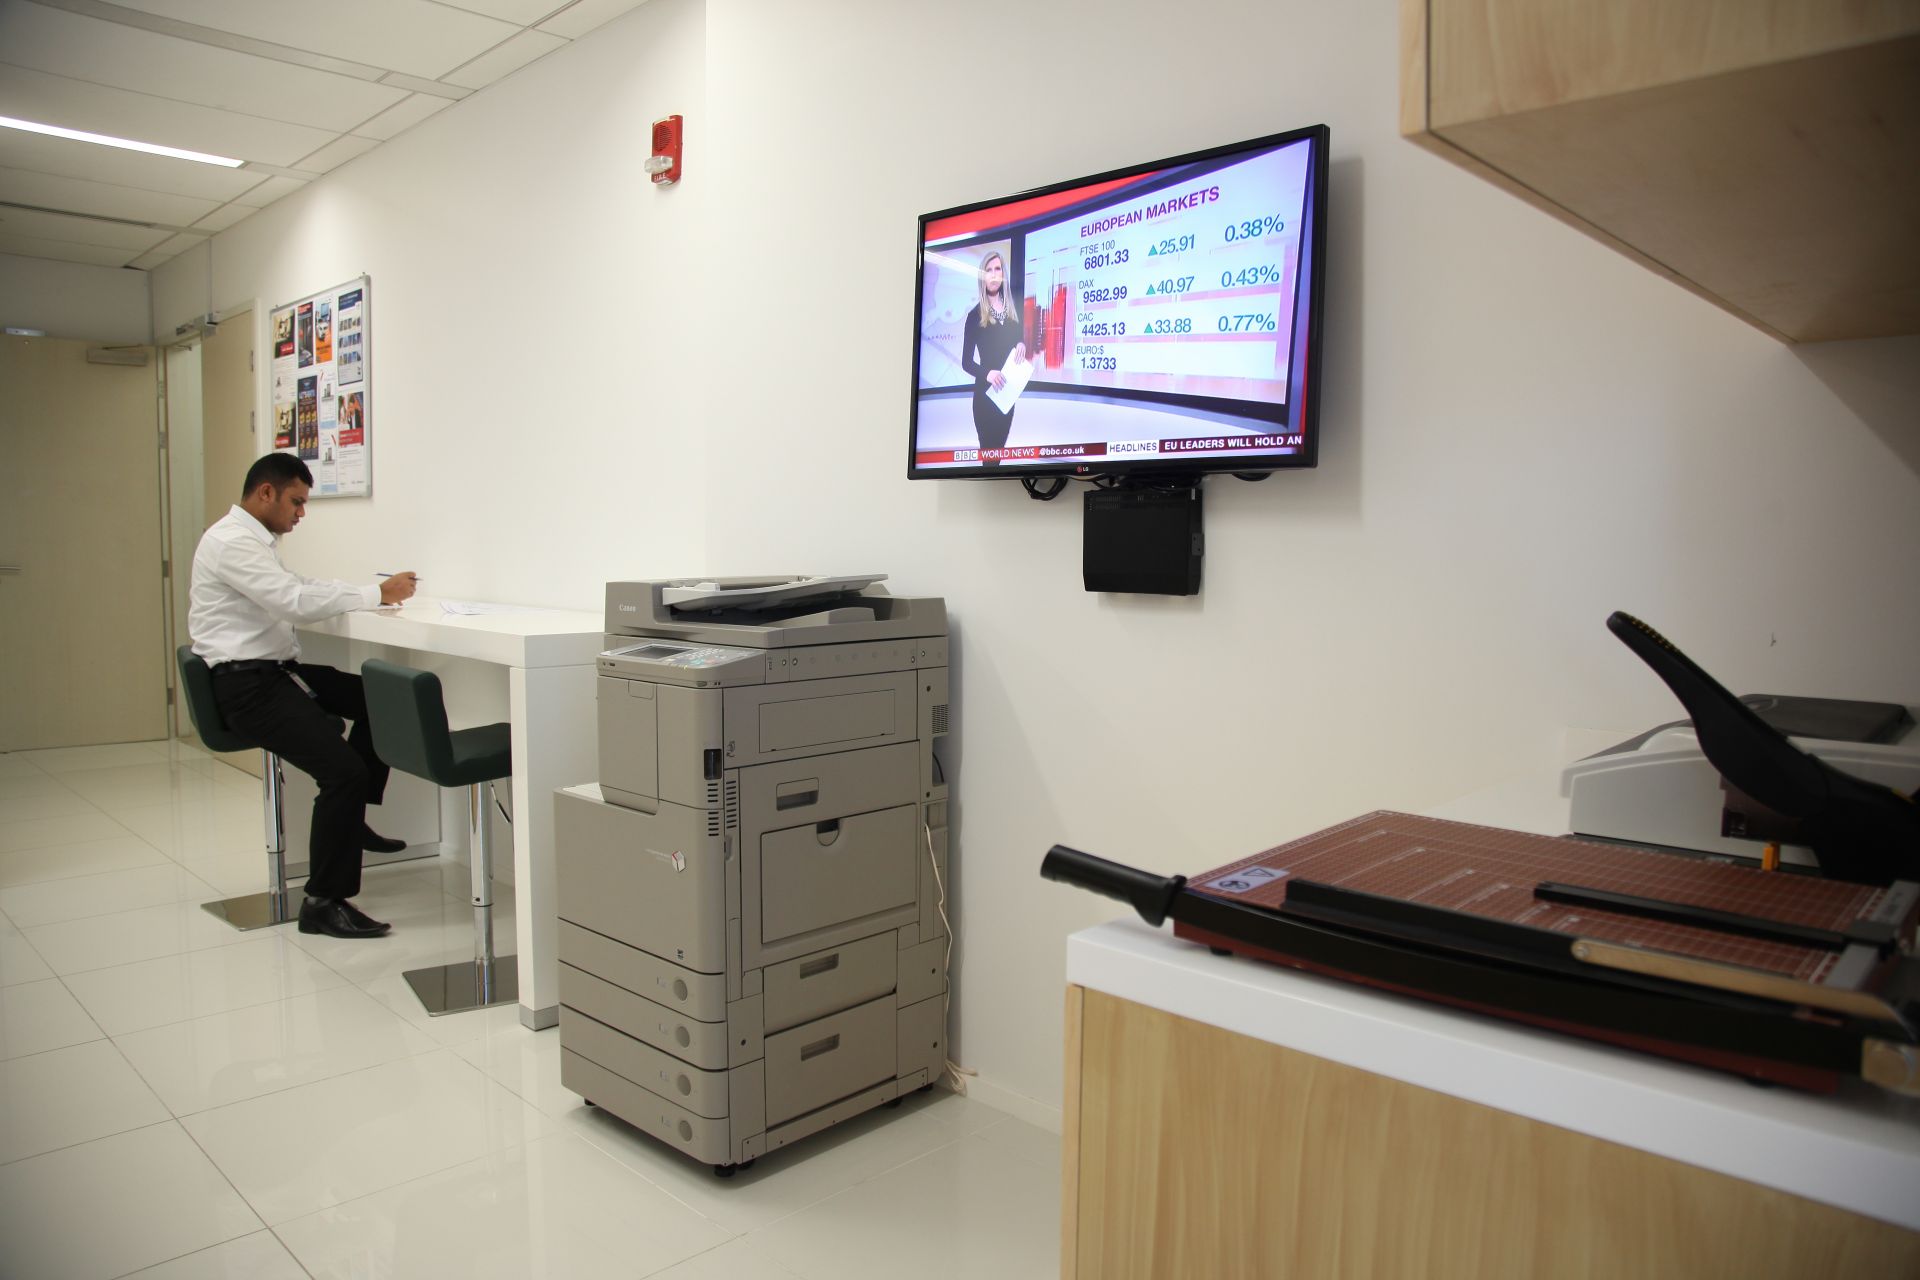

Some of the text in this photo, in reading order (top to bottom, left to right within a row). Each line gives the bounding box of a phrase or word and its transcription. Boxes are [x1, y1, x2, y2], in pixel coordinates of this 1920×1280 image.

[1080, 186, 1220, 238] EUROPEAN MARKETS
[1224, 213, 1284, 242] 0.38%
[1080, 240, 1116, 256] FTSE 100
[1159, 234, 1195, 256] 25.91
[1084, 249, 1129, 270] 6801.33
[1079, 279, 1094, 289] DAX
[1221, 264, 1280, 288] 0.43%
[1157, 276, 1195, 294] 40.97
[1083, 286, 1128, 303] 9582.99
[1077, 312, 1094, 322] CAC
[1218, 313, 1276, 332] 0.77%
[1082, 322, 1126, 336] 4425.13
[1154, 318, 1192, 334] 33.88
[1076, 345, 1105, 355] EURO:$
[1081, 357, 1117, 370] 1.3733
[1109, 442, 1157, 453] HEADLINES
[1164, 435, 1302, 450] EU LEADERS WILL HOLD AN
[954, 448, 1035, 461] BBC WORLD NEWS
[1039, 446, 1085, 456] @bbc.co.uk
